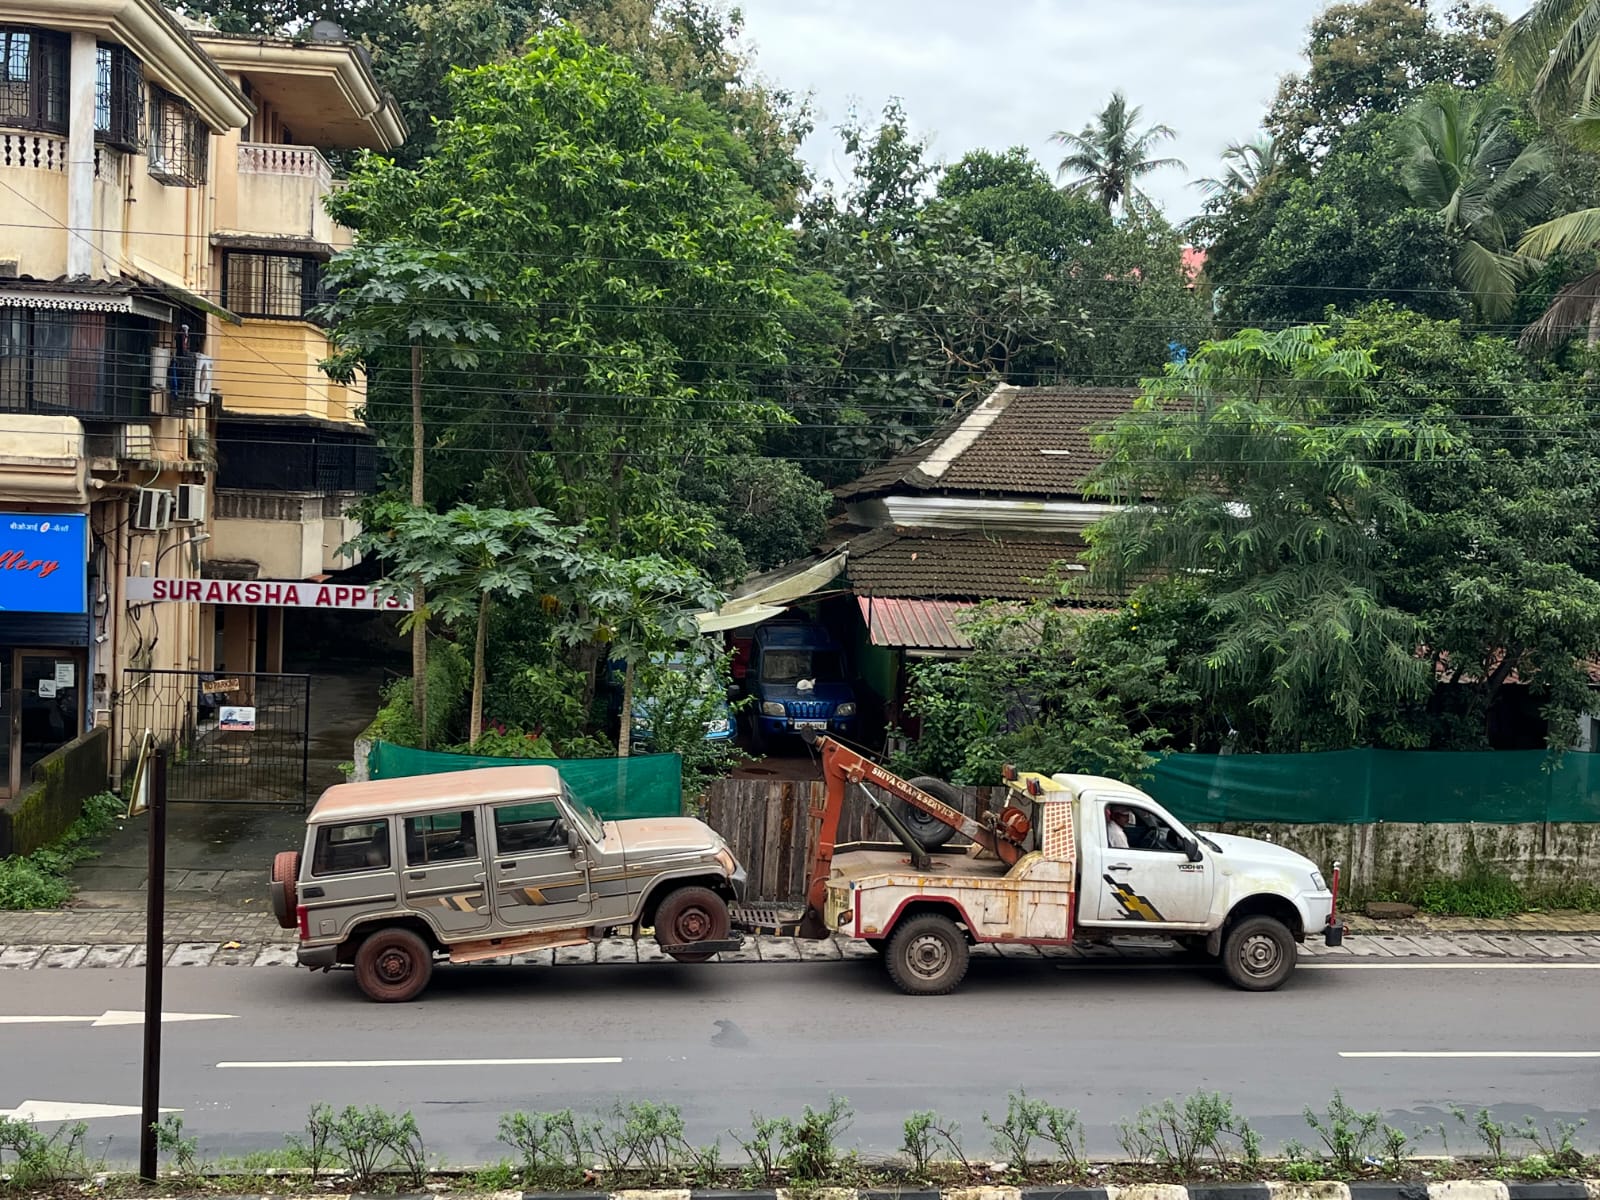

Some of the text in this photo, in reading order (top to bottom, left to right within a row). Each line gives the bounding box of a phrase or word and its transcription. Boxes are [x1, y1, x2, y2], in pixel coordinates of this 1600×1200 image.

[153, 580, 300, 605] SURAKSHA
[871, 767, 955, 819] SHIVA CRANE SERVICE
